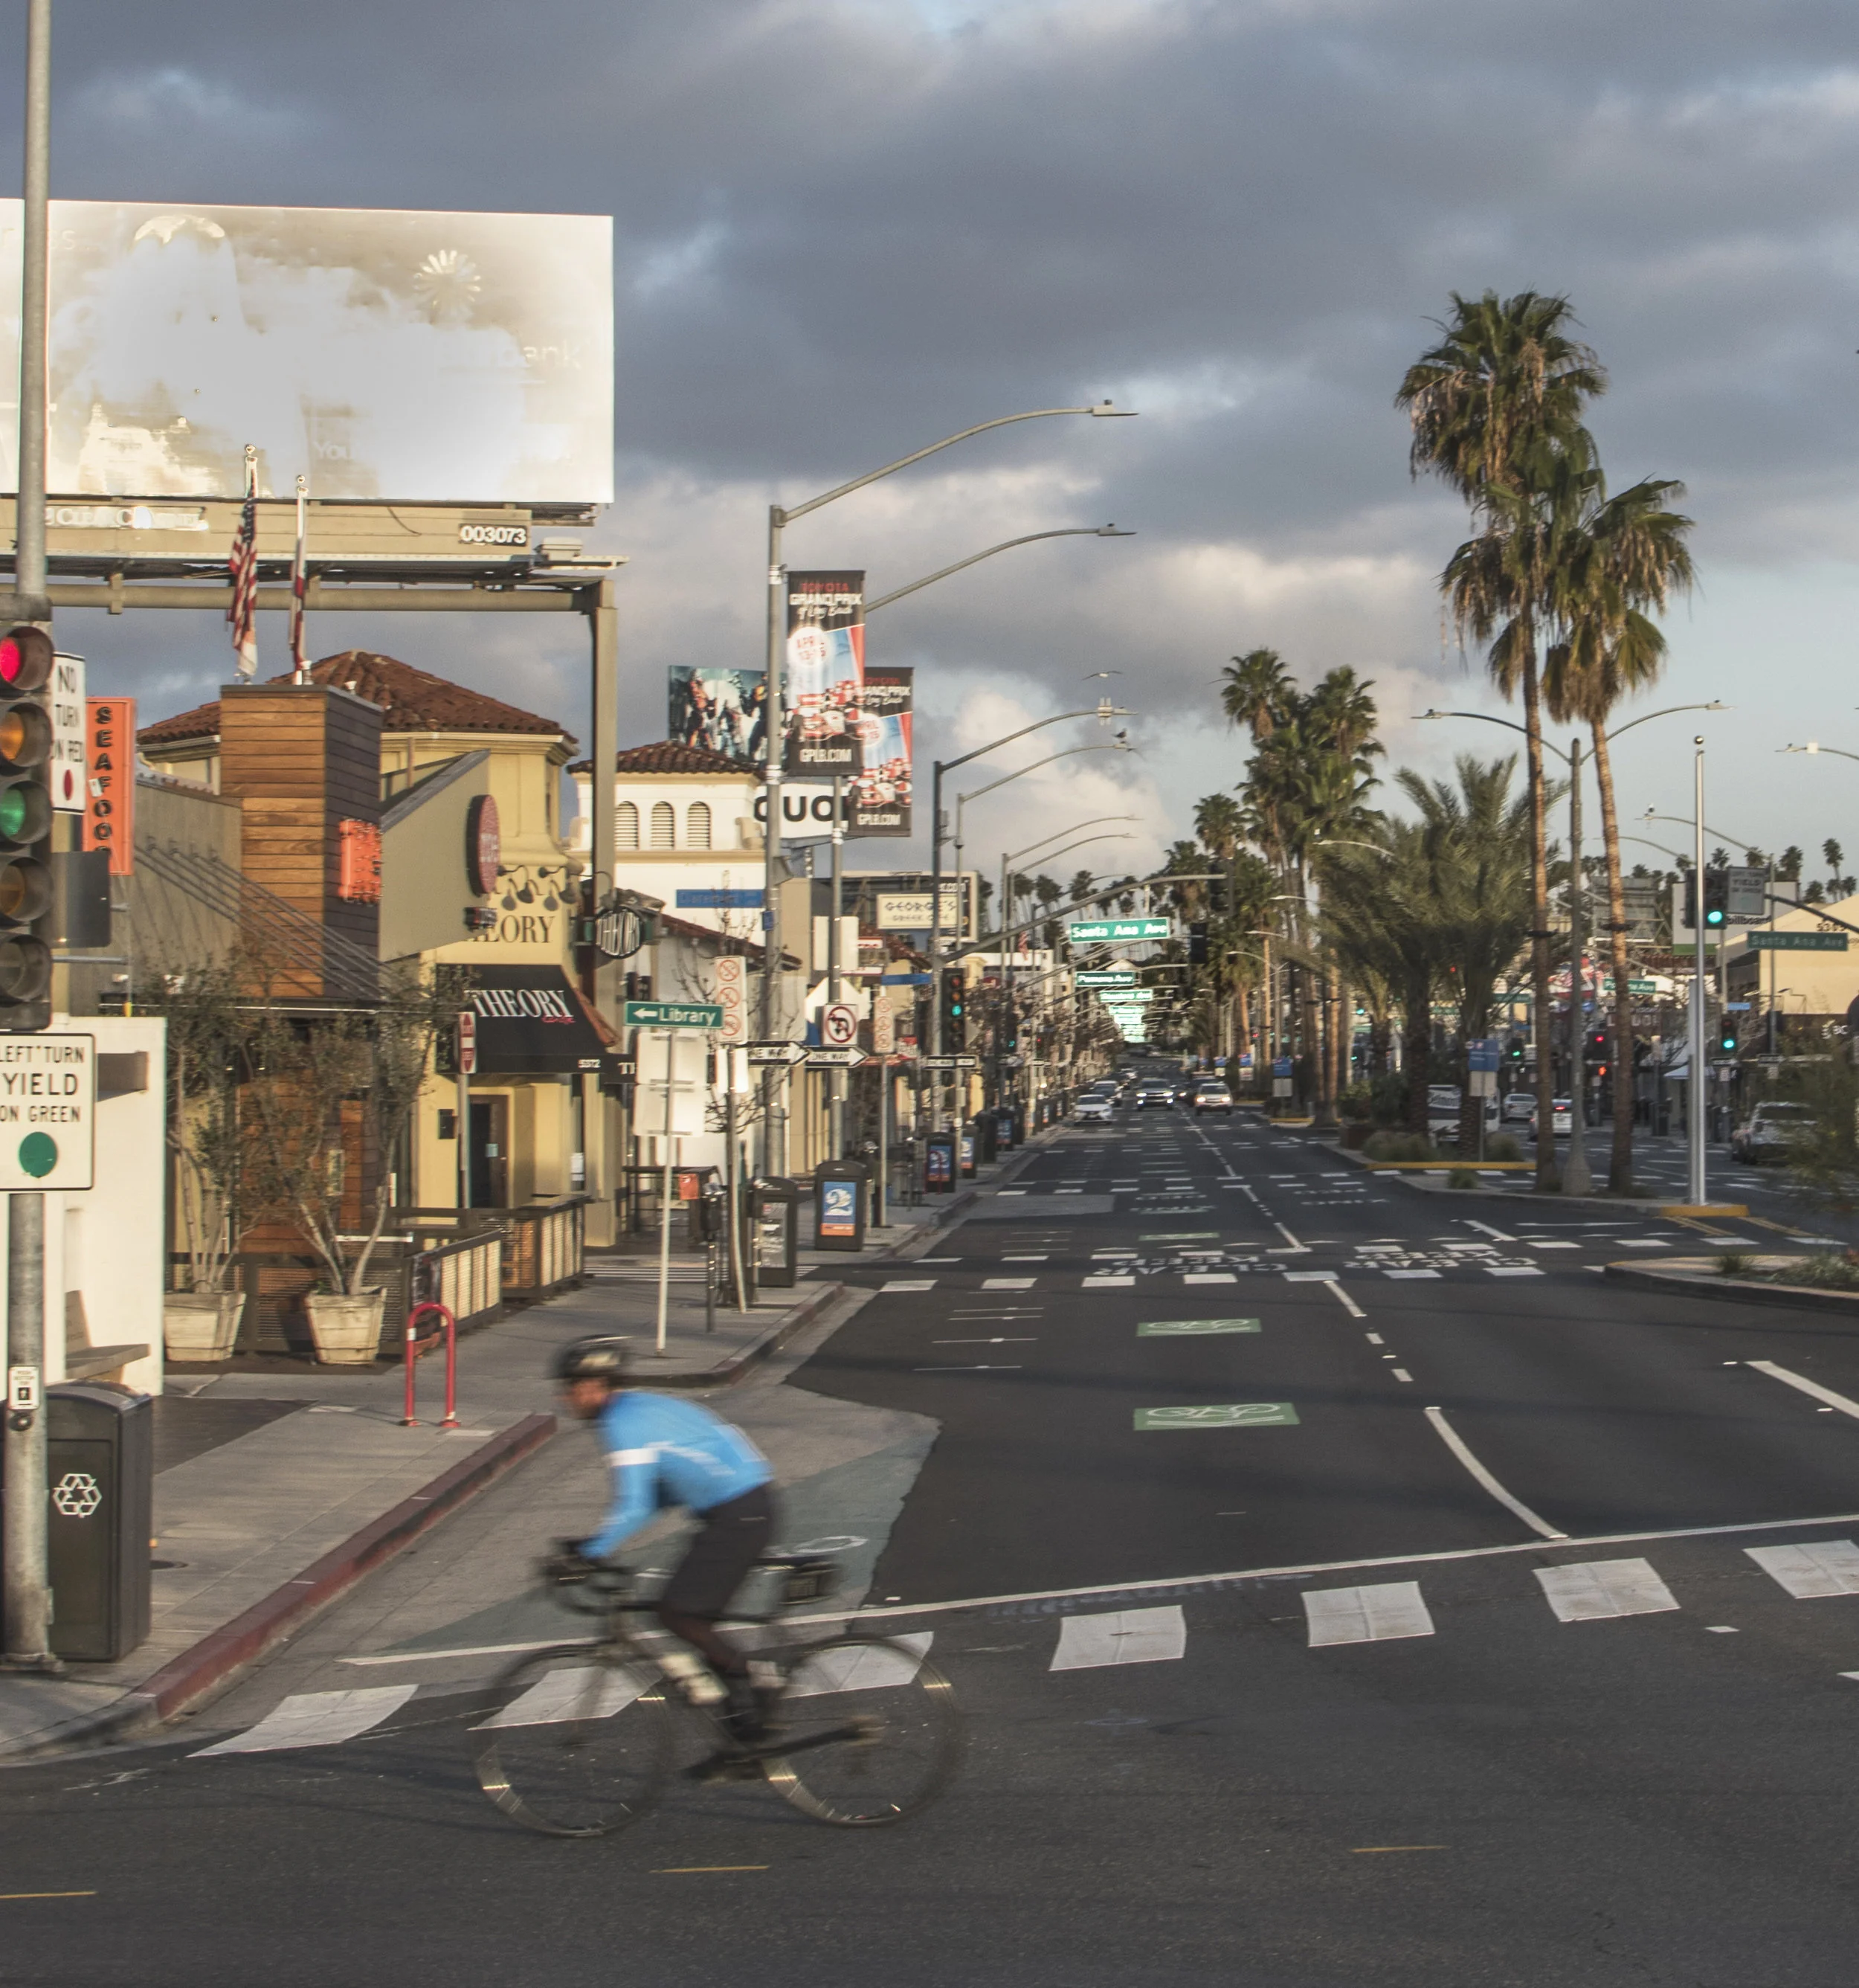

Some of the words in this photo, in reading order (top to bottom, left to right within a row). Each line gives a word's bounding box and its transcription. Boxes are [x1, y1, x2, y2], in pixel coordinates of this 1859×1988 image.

[460, 525, 526, 544] 003073
[802, 582, 849, 592] TOYOTA
[58, 666, 77, 693] NO
[864, 677, 900, 685] OYOTA
[55, 704, 80, 727] TURN
[68, 740, 84, 762] RED
[94, 707, 113, 852] SEAFOO
[1072, 927, 1109, 938] Santa
[1113, 924, 1139, 936] Ana
[1144, 923, 1167, 935] Ave
[1751, 936, 1787, 945] Santa
[1793, 936, 1817, 947] Ana
[1823, 937, 1844, 948] Ave
[464, 990, 574, 1017] THEORY
[659, 1008, 717, 1026] Library
[45, 1046, 85, 1064] TURN
[813, 1052, 828, 1061] ONE
[831, 1053, 849, 1061] WAY
[3, 1072, 79, 1096] YIELD
[0, 1105, 19, 1122] ON
[28, 1105, 81, 1122] GREEN
[1093, 1264, 1288, 1276] CLEAR
